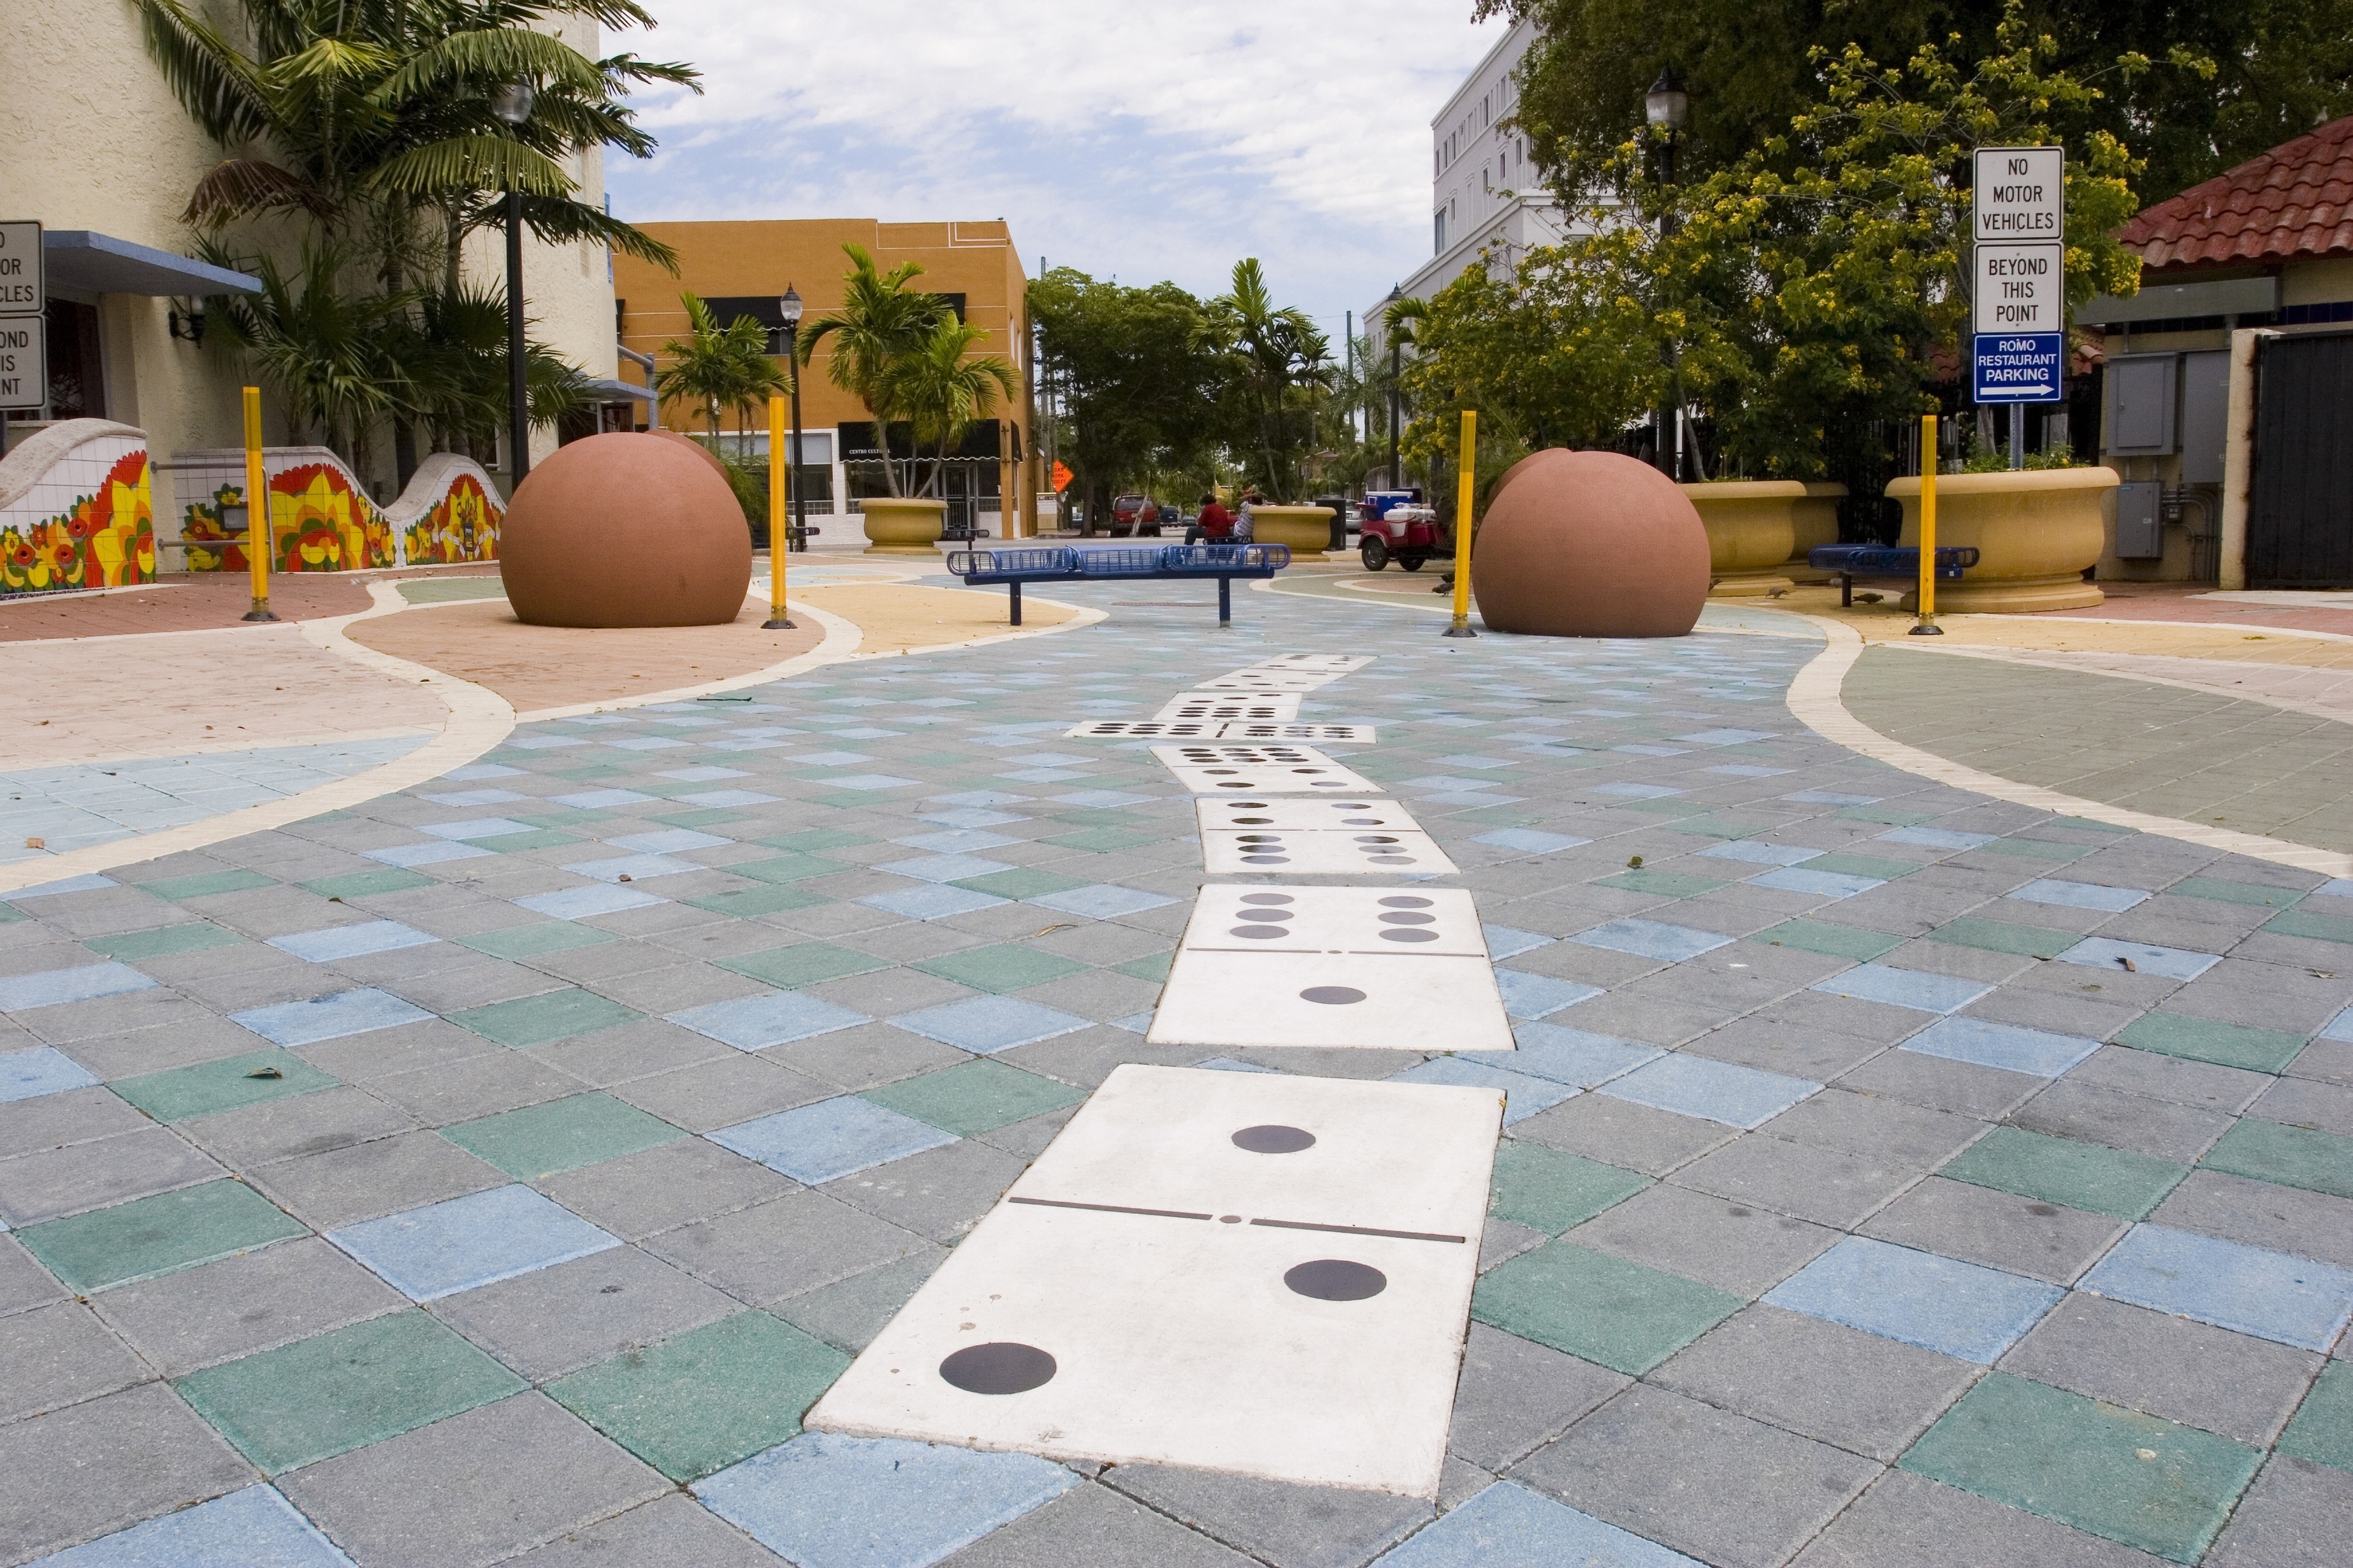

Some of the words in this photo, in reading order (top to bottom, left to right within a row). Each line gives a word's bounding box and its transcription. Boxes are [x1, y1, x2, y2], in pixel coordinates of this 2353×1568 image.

[2008, 159, 2028, 175] NO
[1993, 185, 2043, 203] MOTOR
[1982, 212, 2053, 230] VEHICLES
[1, 259, 21, 275] OR
[1989, 259, 2047, 275] BEYOND
[2002, 282, 2034, 298] THIS
[1997, 305, 2039, 322] POINT
[0, 331, 29, 349] OND
[1999, 340, 2036, 352] ROMO
[1, 355, 15, 371] IS
[1978, 354, 2057, 366] RESTAURANT
[1986, 368, 2049, 382] PARKING
[2, 378, 21, 395] NT
